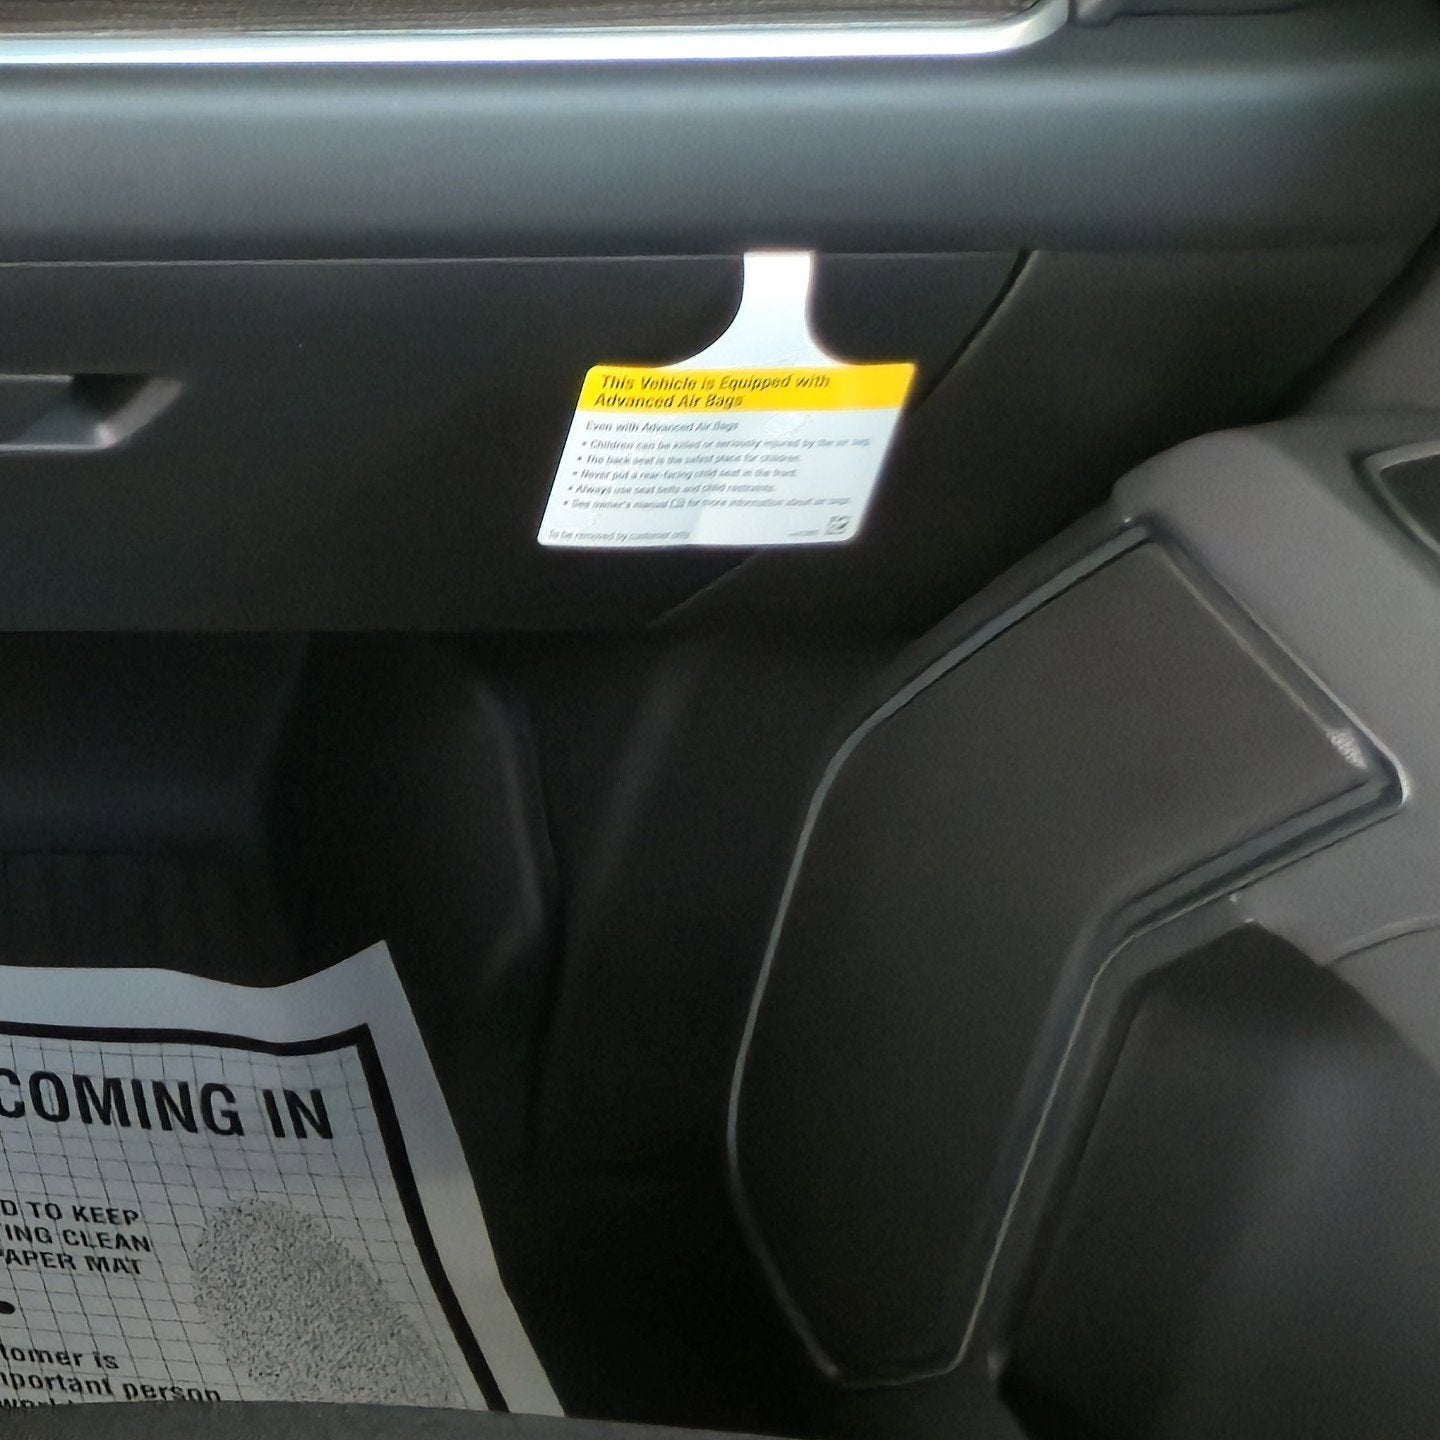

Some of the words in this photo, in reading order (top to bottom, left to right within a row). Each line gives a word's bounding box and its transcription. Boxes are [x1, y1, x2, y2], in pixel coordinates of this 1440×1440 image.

[601, 374, 634, 390] This
[641, 375, 695, 391] Vehicle
[701, 376, 715, 390] is
[720, 374, 792, 392] Equipped
[796, 374, 830, 389] with
[594, 393, 674, 408] Advanced
[677, 394, 702, 408] Air
[705, 394, 745, 409] Bags
[586, 420, 612, 431] Even
[616, 420, 639, 432] with
[641, 420, 694, 432] Advanced
[262, 1087, 334, 1139] IN
[26, 1201, 63, 1220] TO
[72, 1205, 139, 1226] KEEP
[62, 1229, 151, 1252] CLEAN
[84, 1255, 143, 1275] MAT
[93, 1351, 120, 1370] is
[122, 1381, 221, 1403] person
